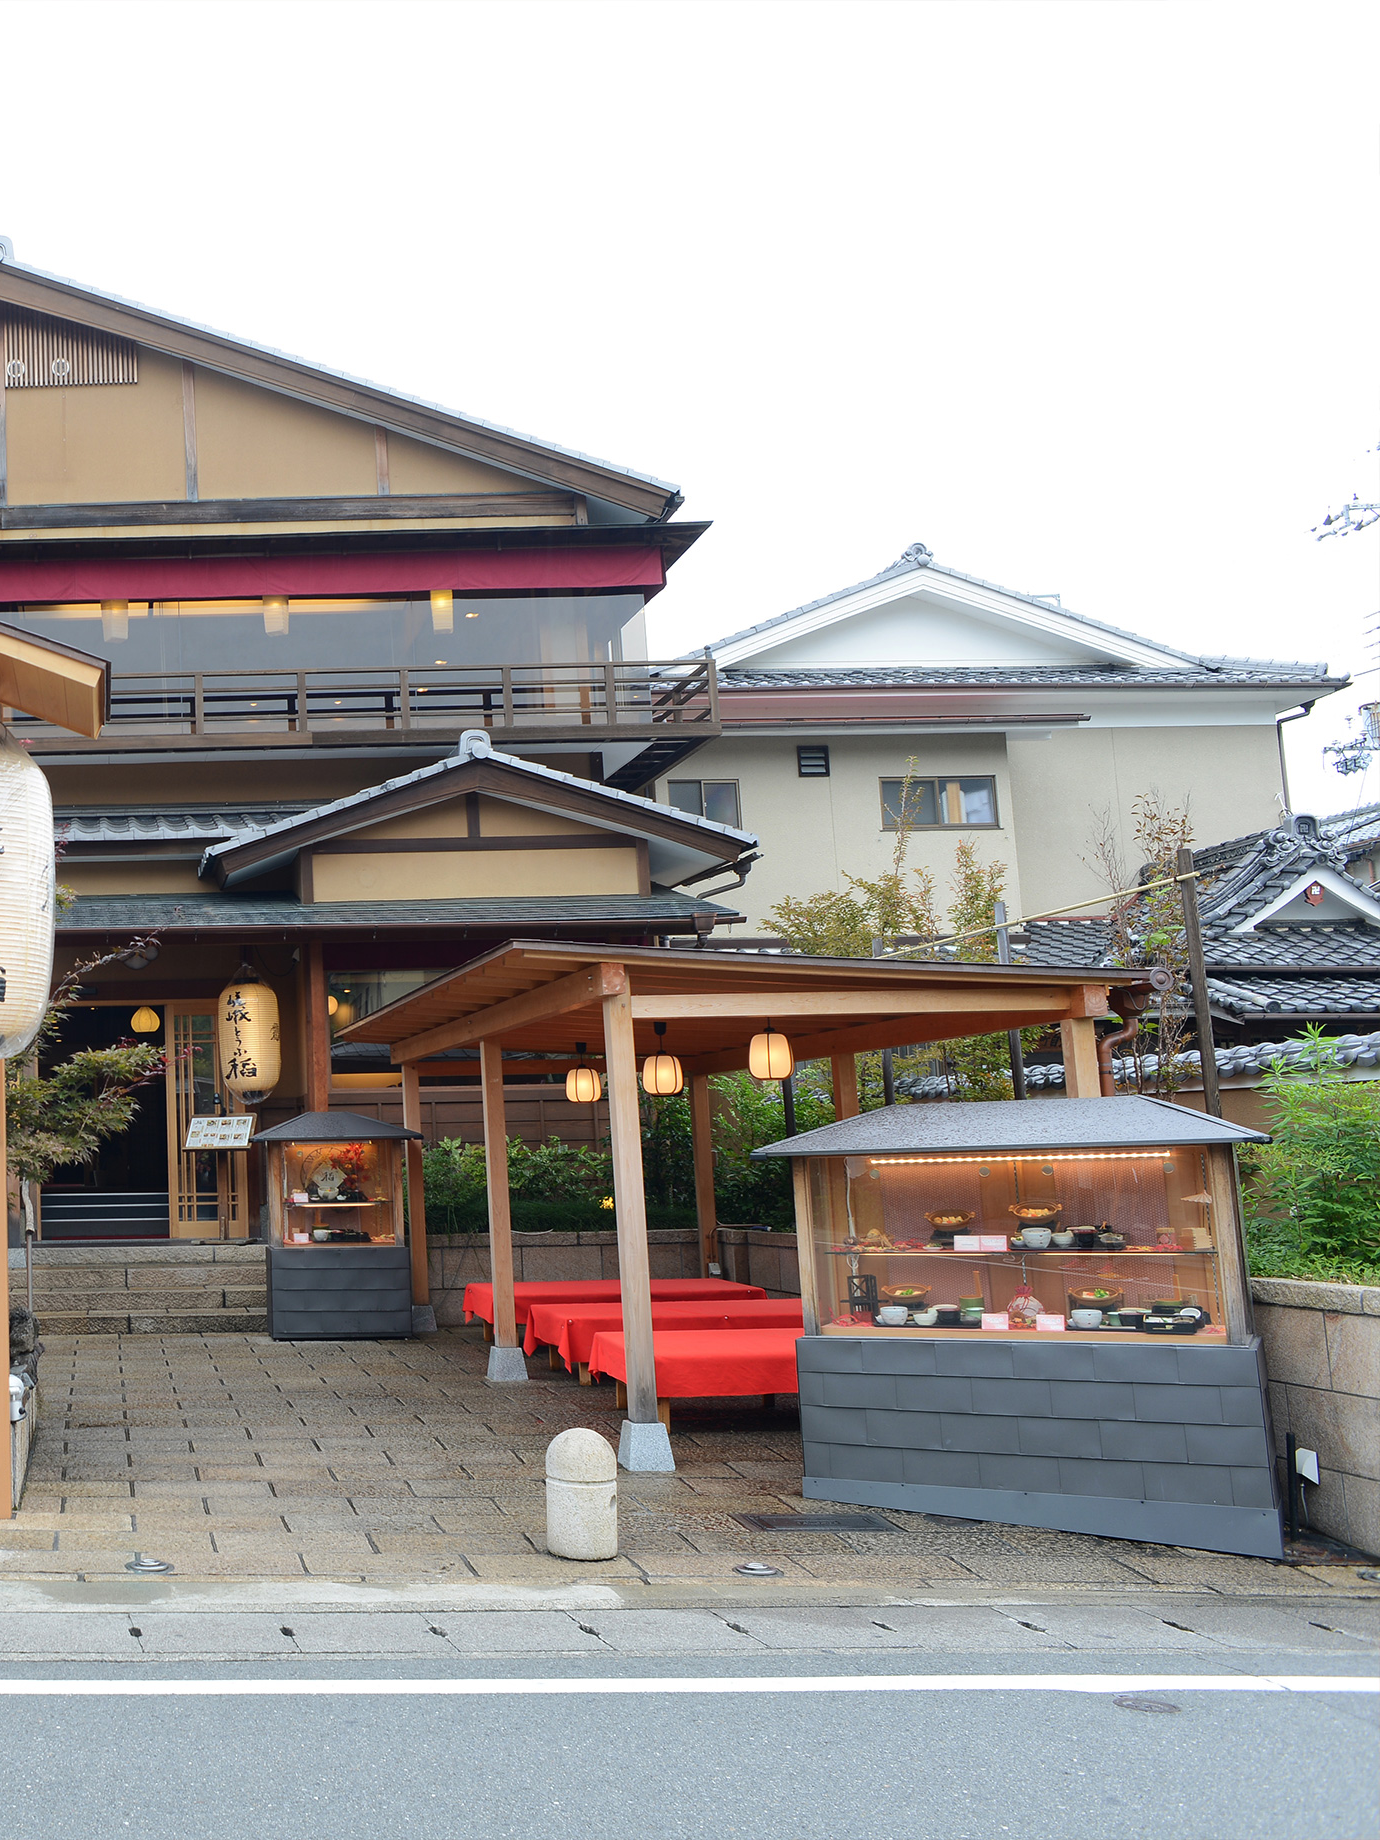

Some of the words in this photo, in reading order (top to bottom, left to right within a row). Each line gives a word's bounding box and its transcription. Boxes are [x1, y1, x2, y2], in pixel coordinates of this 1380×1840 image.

[225, 991, 258, 1080] 嵯峨とうふ稲
